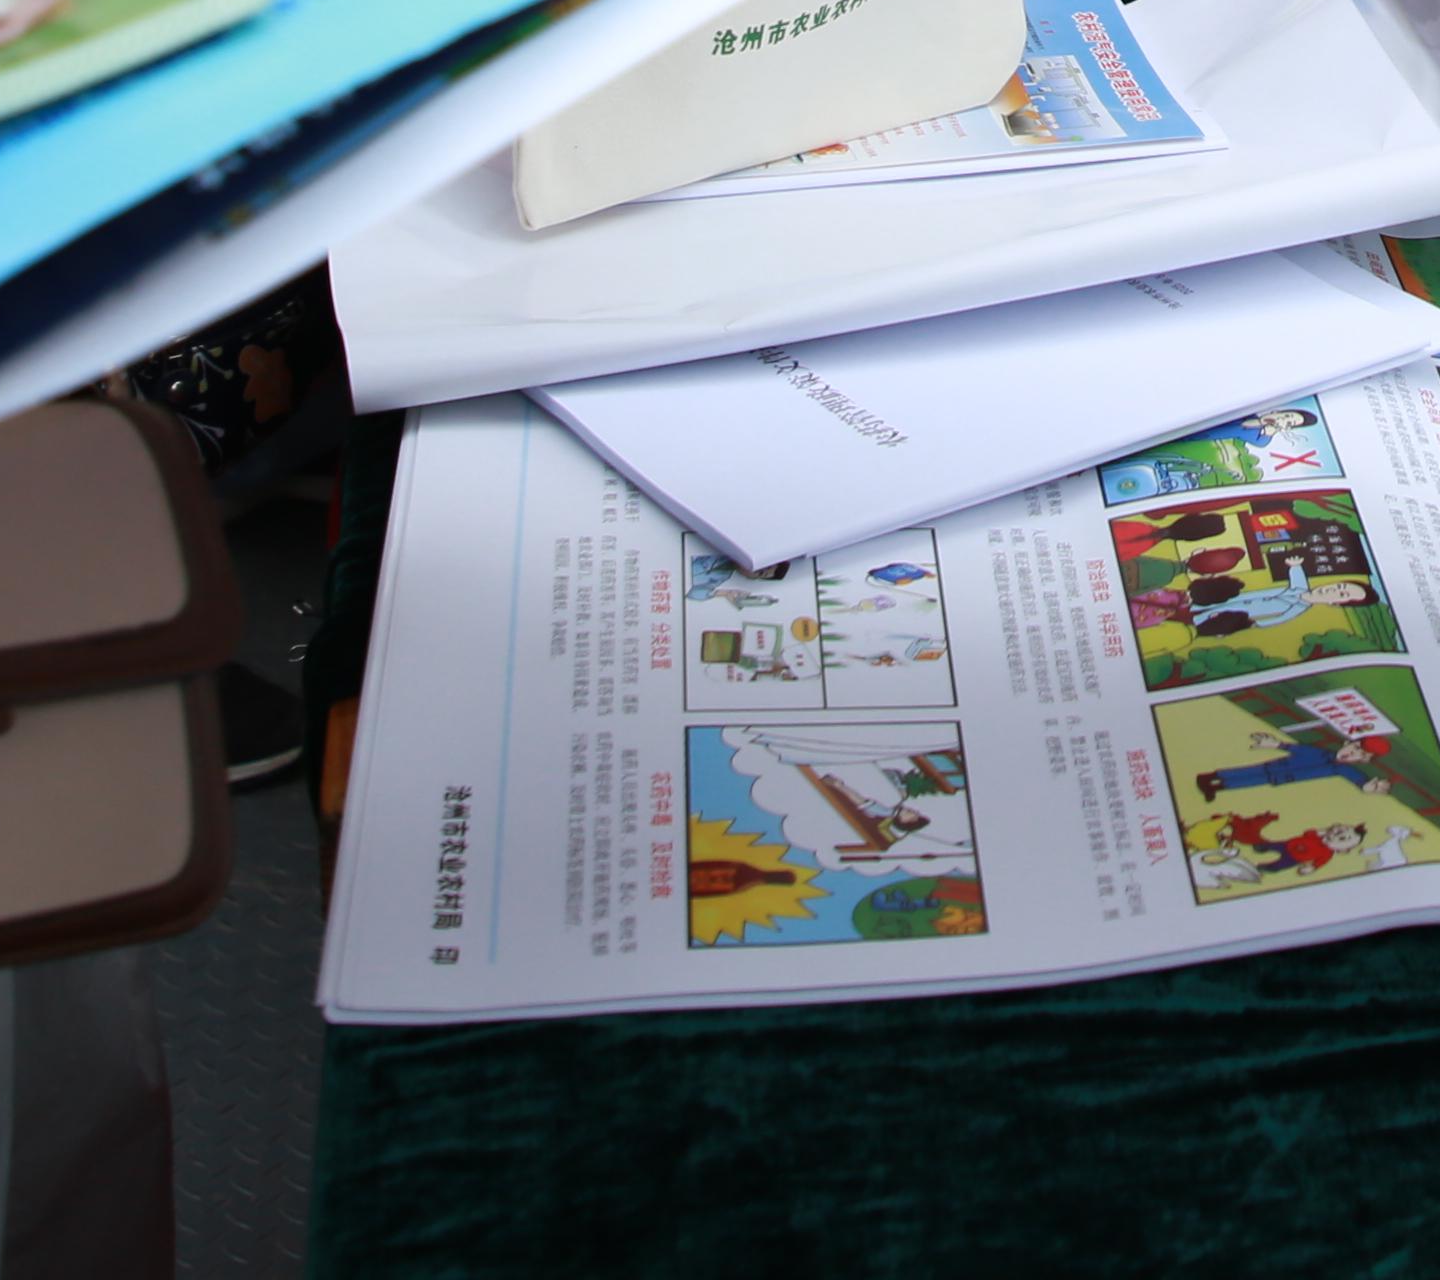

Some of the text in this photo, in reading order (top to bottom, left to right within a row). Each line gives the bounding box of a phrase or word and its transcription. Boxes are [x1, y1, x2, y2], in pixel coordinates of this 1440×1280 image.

[650, 622, 672, 670] 分类处置
[1100, 611, 1125, 658] 科学用药
[649, 771, 673, 899] 农药中毒 及时抢救
[1139, 811, 1169, 867] 人畜莫入
[428, 785, 473, 968] 沧州市农业农村局 印
